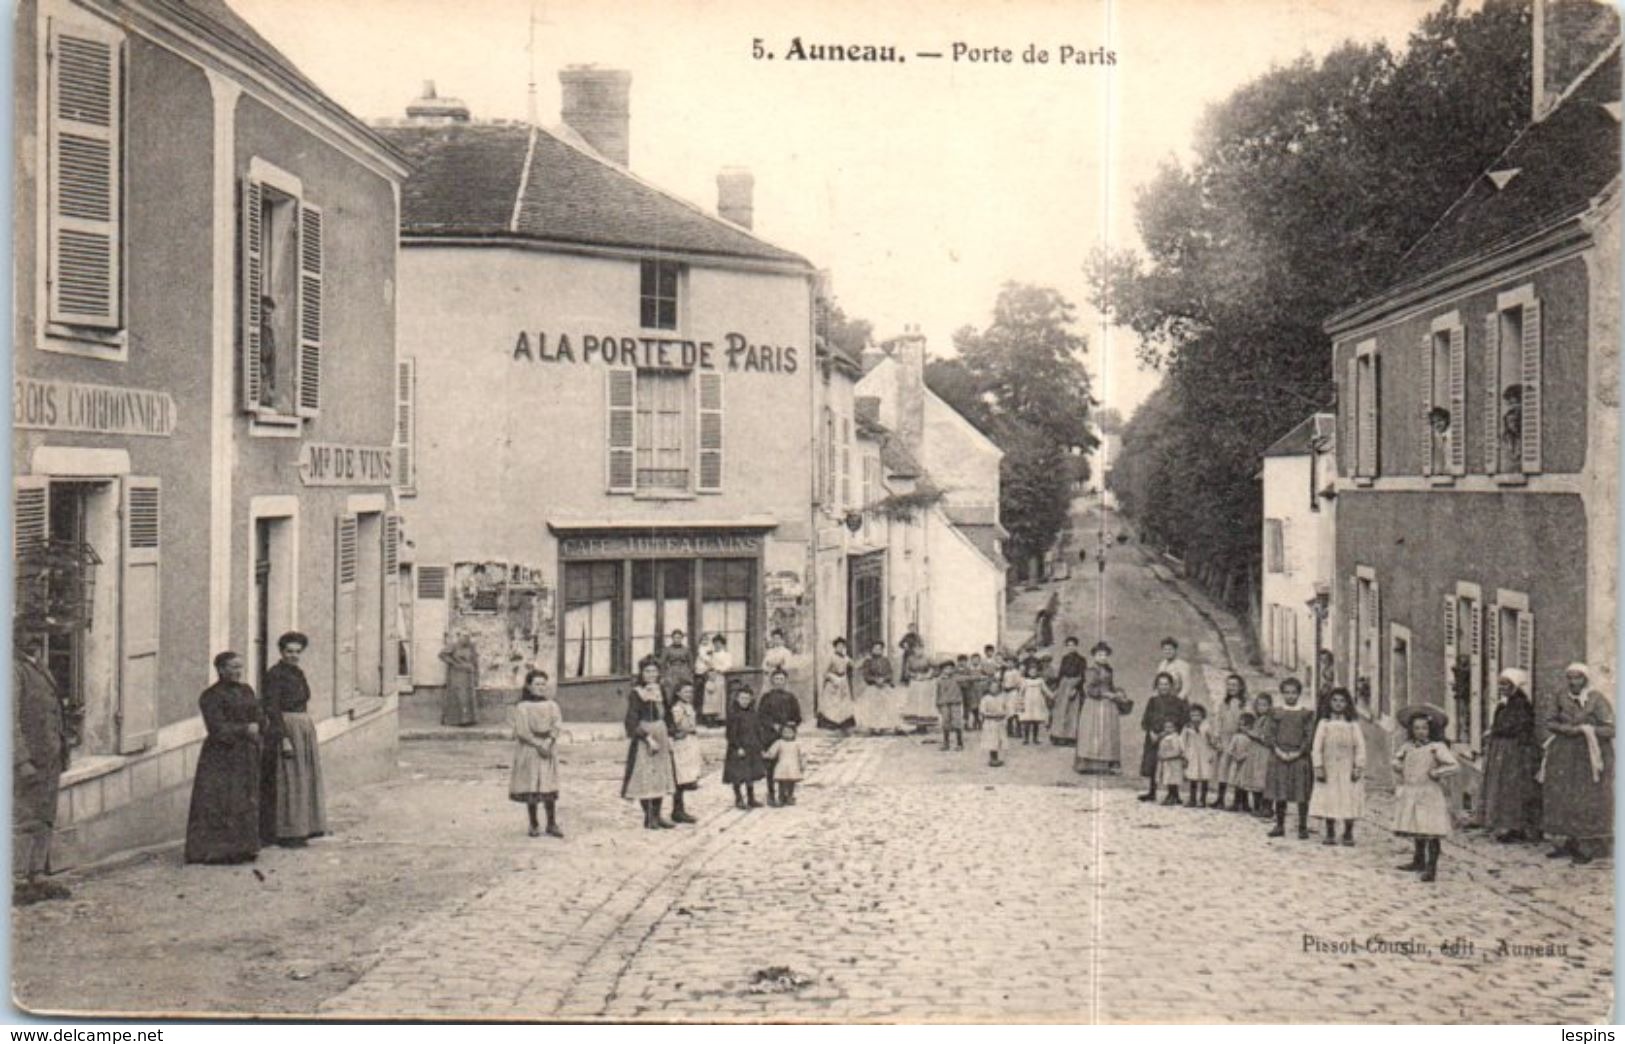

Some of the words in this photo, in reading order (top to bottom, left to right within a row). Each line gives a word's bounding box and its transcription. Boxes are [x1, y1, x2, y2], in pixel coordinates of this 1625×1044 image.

[513, 331, 532, 361] A
[539, 332, 575, 363] LA
[583, 335, 672, 367] PORTE
[681, 341, 714, 369] DE
[724, 332, 798, 374] PARIS
[67, 386, 170, 433] CORDONNIER
[335, 448, 354, 479] DE
[359, 449, 391, 480] VINS
